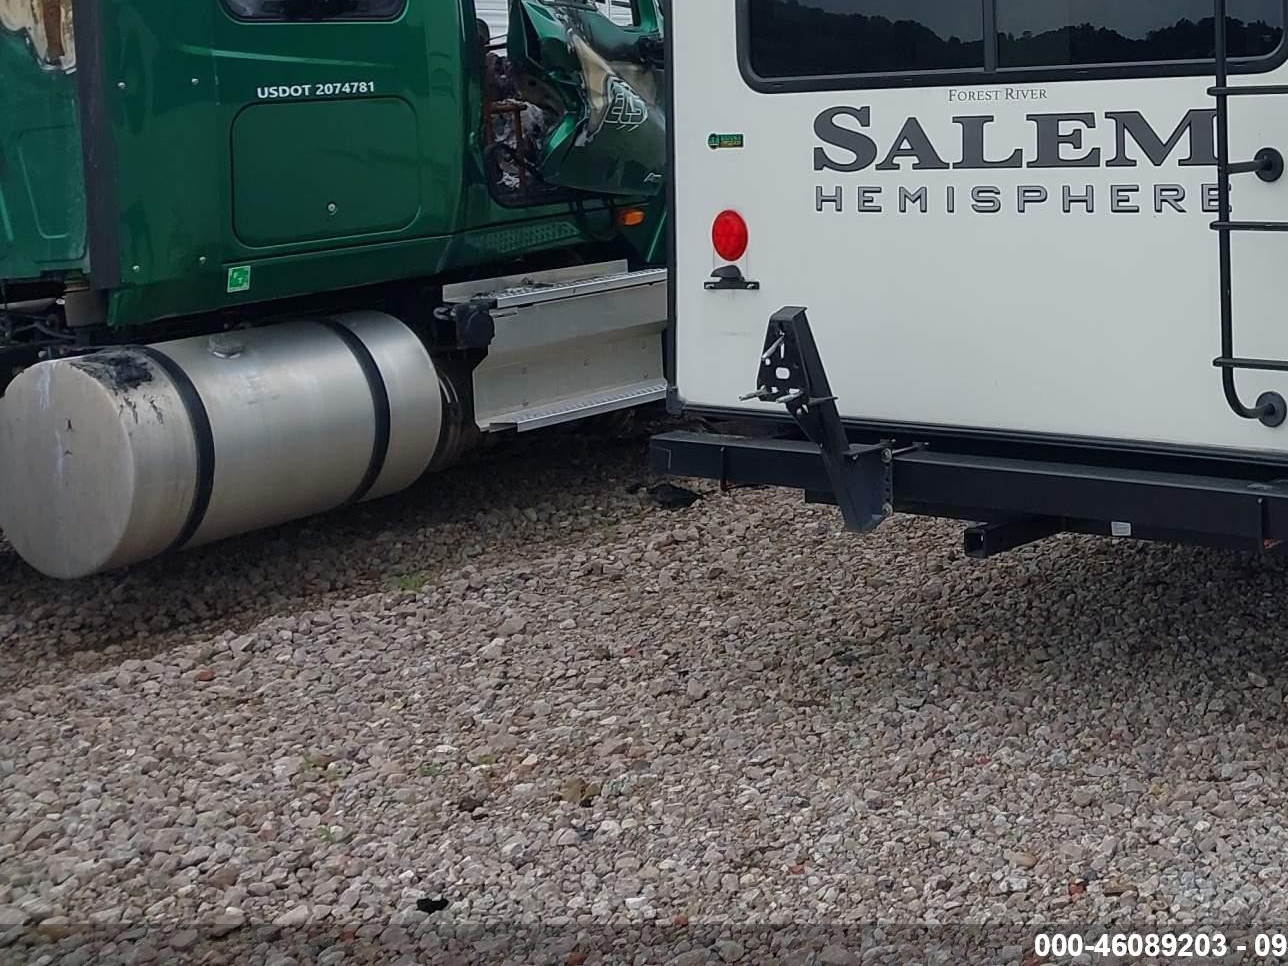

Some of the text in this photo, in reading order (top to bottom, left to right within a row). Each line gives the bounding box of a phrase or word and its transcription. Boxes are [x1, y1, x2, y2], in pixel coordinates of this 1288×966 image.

[256, 81, 375, 99] USDOT 2074781
[948, 87, 1048, 102] FOREST RIVER
[813, 105, 1219, 173] SALEM
[815, 183, 1233, 214] HEMISPHERE
